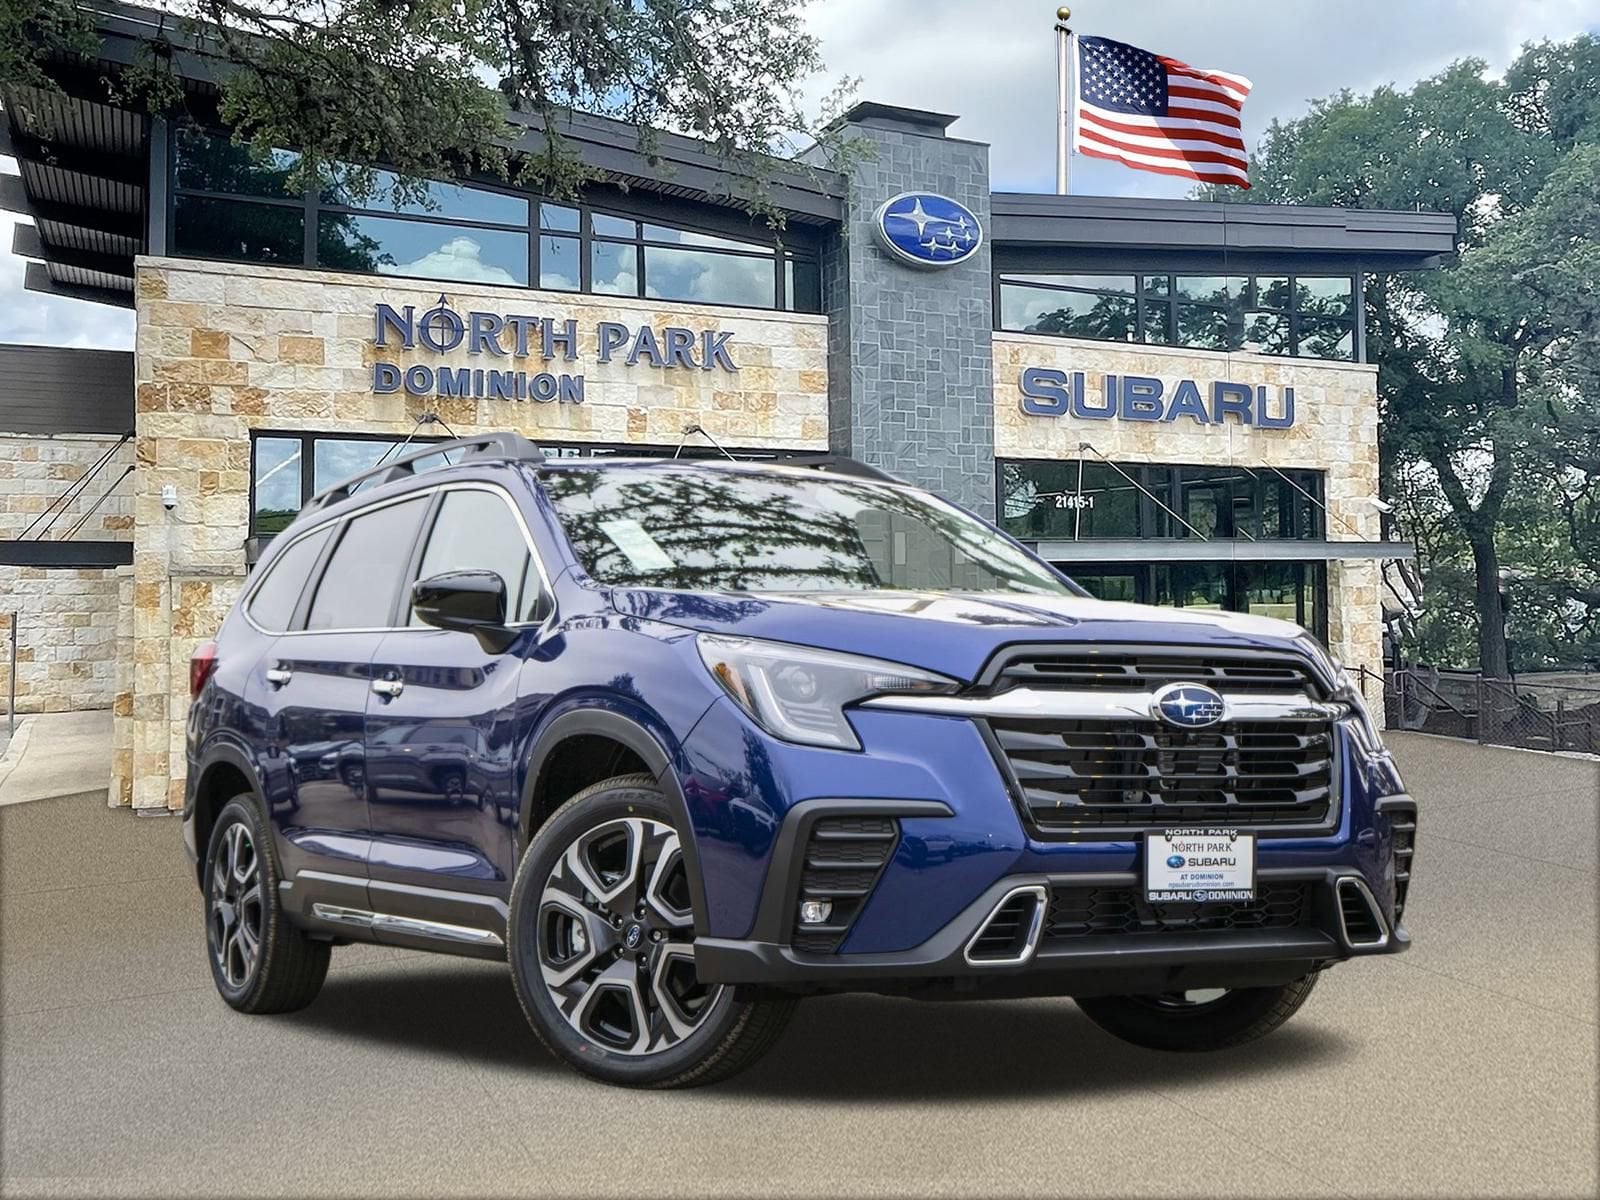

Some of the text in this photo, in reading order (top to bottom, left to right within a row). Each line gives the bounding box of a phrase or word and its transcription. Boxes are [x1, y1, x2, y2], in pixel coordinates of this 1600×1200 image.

[374, 302, 742, 373] NORTH PARK
[373, 362, 585, 404] DOMINION
[1018, 367, 1295, 429] SUBARU
[1172, 842, 1232, 853] NORTH PARK
[1188, 857, 1236, 867] SUBARU
[1149, 890, 1254, 901] SUBARU DOMINION
